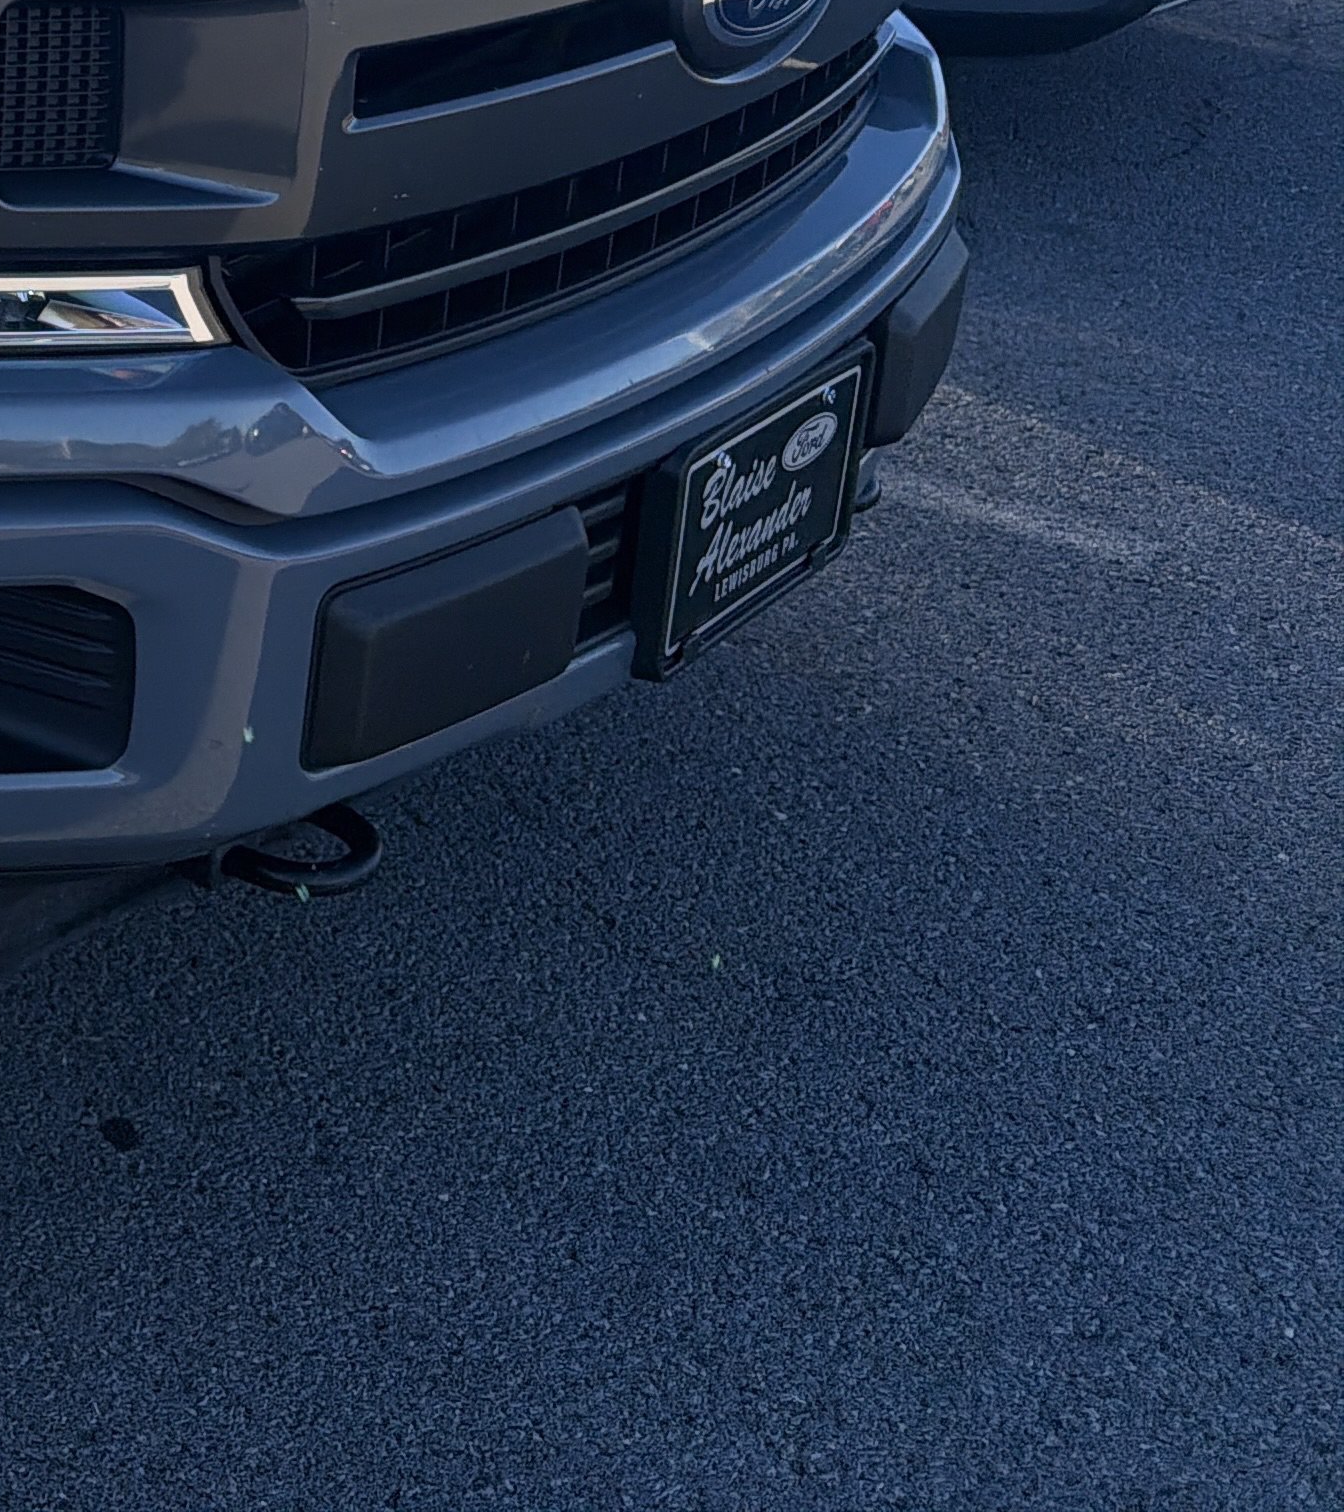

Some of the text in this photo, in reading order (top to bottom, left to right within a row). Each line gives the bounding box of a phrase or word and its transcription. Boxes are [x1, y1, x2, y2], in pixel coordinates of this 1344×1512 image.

[792, 422, 828, 463] Ford
[700, 455, 777, 529] Blaise
[689, 479, 812, 598] Alexander
[714, 543, 779, 603] LEWISBURG
